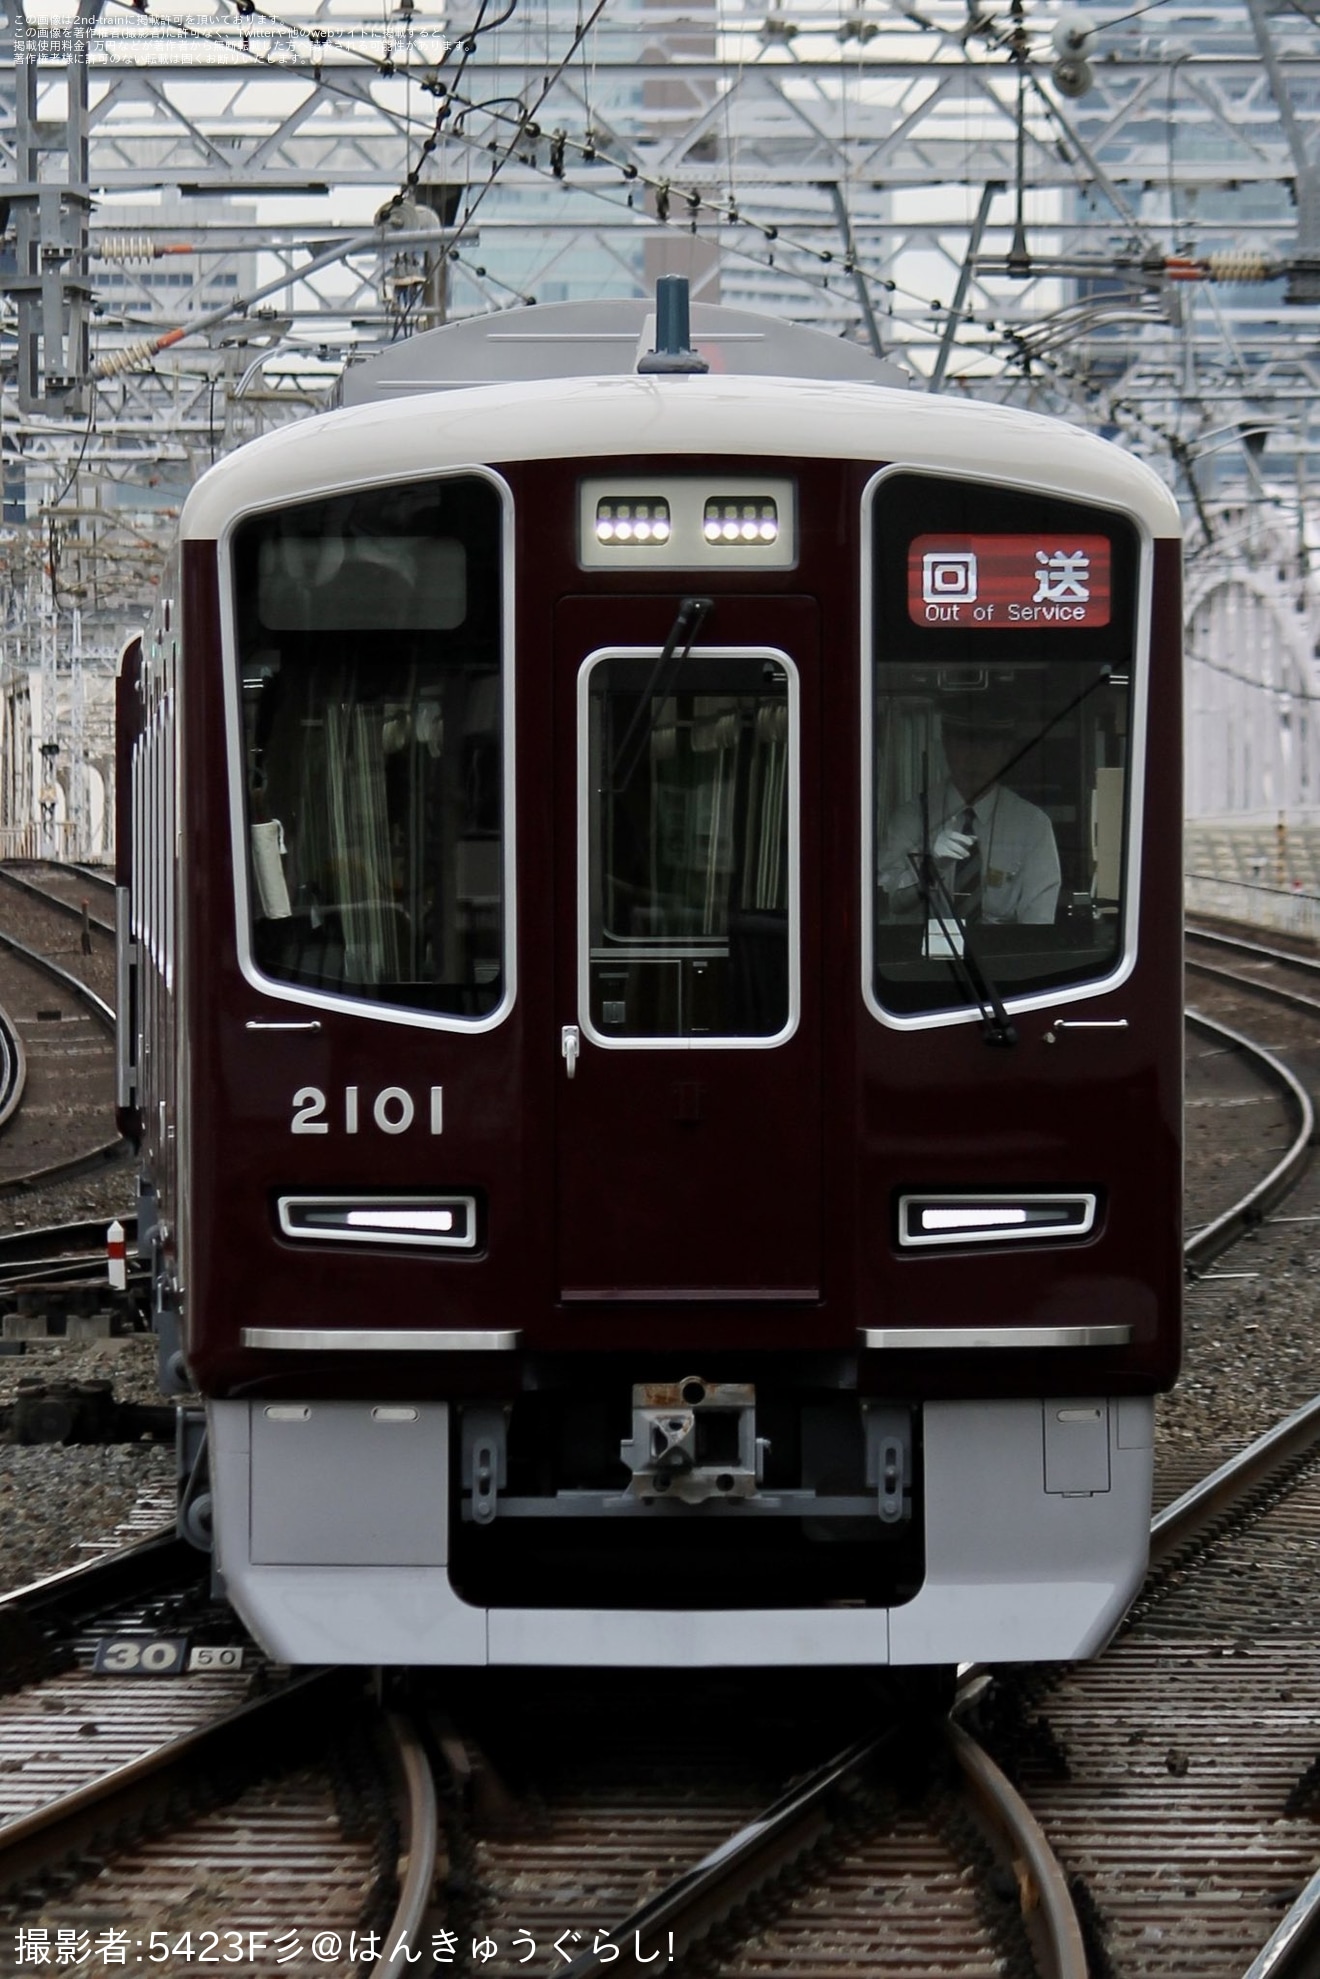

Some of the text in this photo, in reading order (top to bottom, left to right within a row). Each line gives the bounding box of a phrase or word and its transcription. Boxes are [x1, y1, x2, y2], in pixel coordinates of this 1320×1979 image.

[925, 604, 1086, 621] Out of Service
[290, 1085, 443, 1136] 2101
[102, 1641, 177, 1671] 30
[196, 1649, 236, 1666] 50
